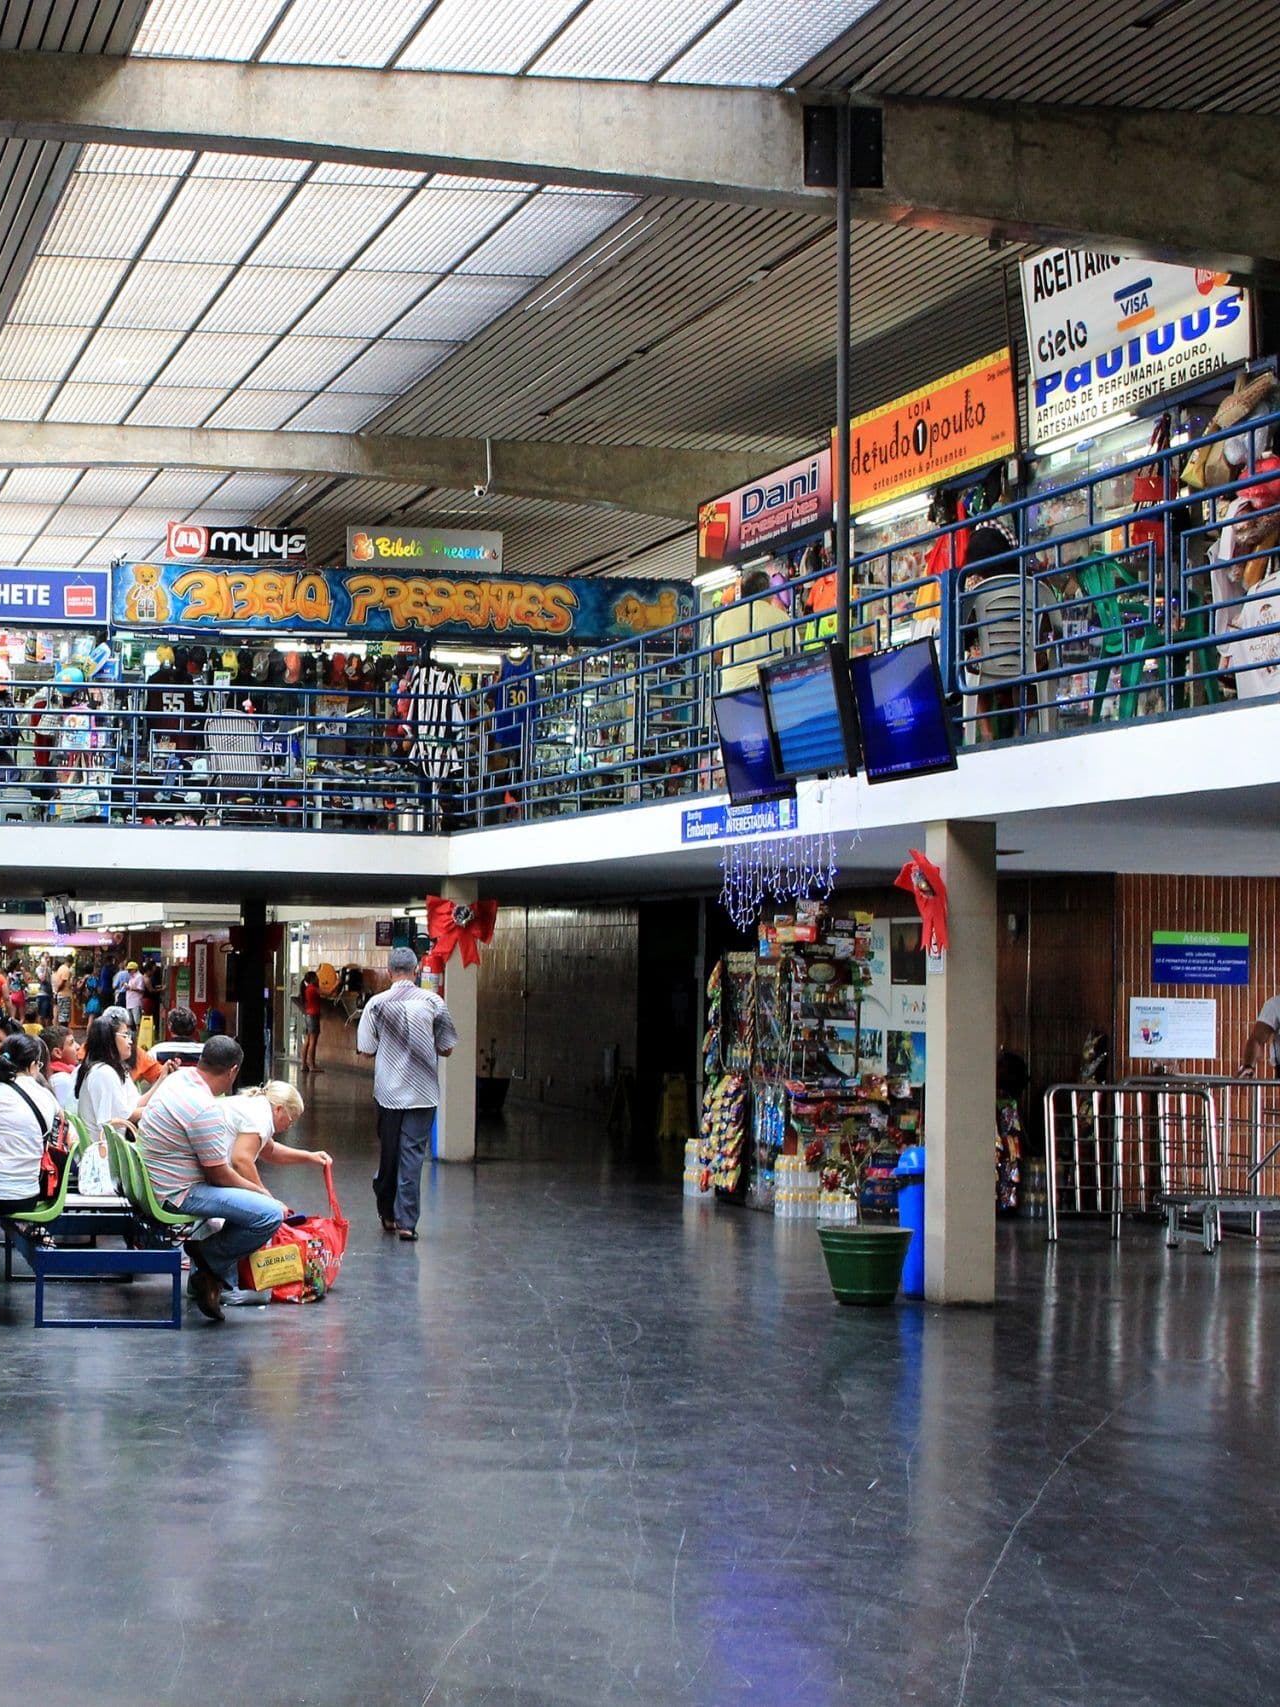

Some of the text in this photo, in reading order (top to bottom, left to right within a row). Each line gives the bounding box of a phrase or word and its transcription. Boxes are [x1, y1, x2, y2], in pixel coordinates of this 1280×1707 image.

[1034, 249, 1130, 303] ACEITAM
[1120, 292, 1150, 317] VISA
[1037, 319, 1088, 363] cielo
[907, 399, 932, 419] LOJA
[1036, 352, 1228, 441] ARTESANATO E PRESENTE EM GERAL
[1036, 395, 1077, 424] ARTIGOS
[1080, 385, 1093, 402] DE
[740, 459, 819, 523] Dani
[740, 497, 818, 540] Presentes
[345, 573, 579, 635] PRESENTES
[162, 692, 185, 713] 55
[509, 690, 526, 706] 30
[687, 821, 718, 839] Embarque
[726, 812, 776, 832] INTERESTADUAL
[1183, 934, 1220, 945] Atenção
